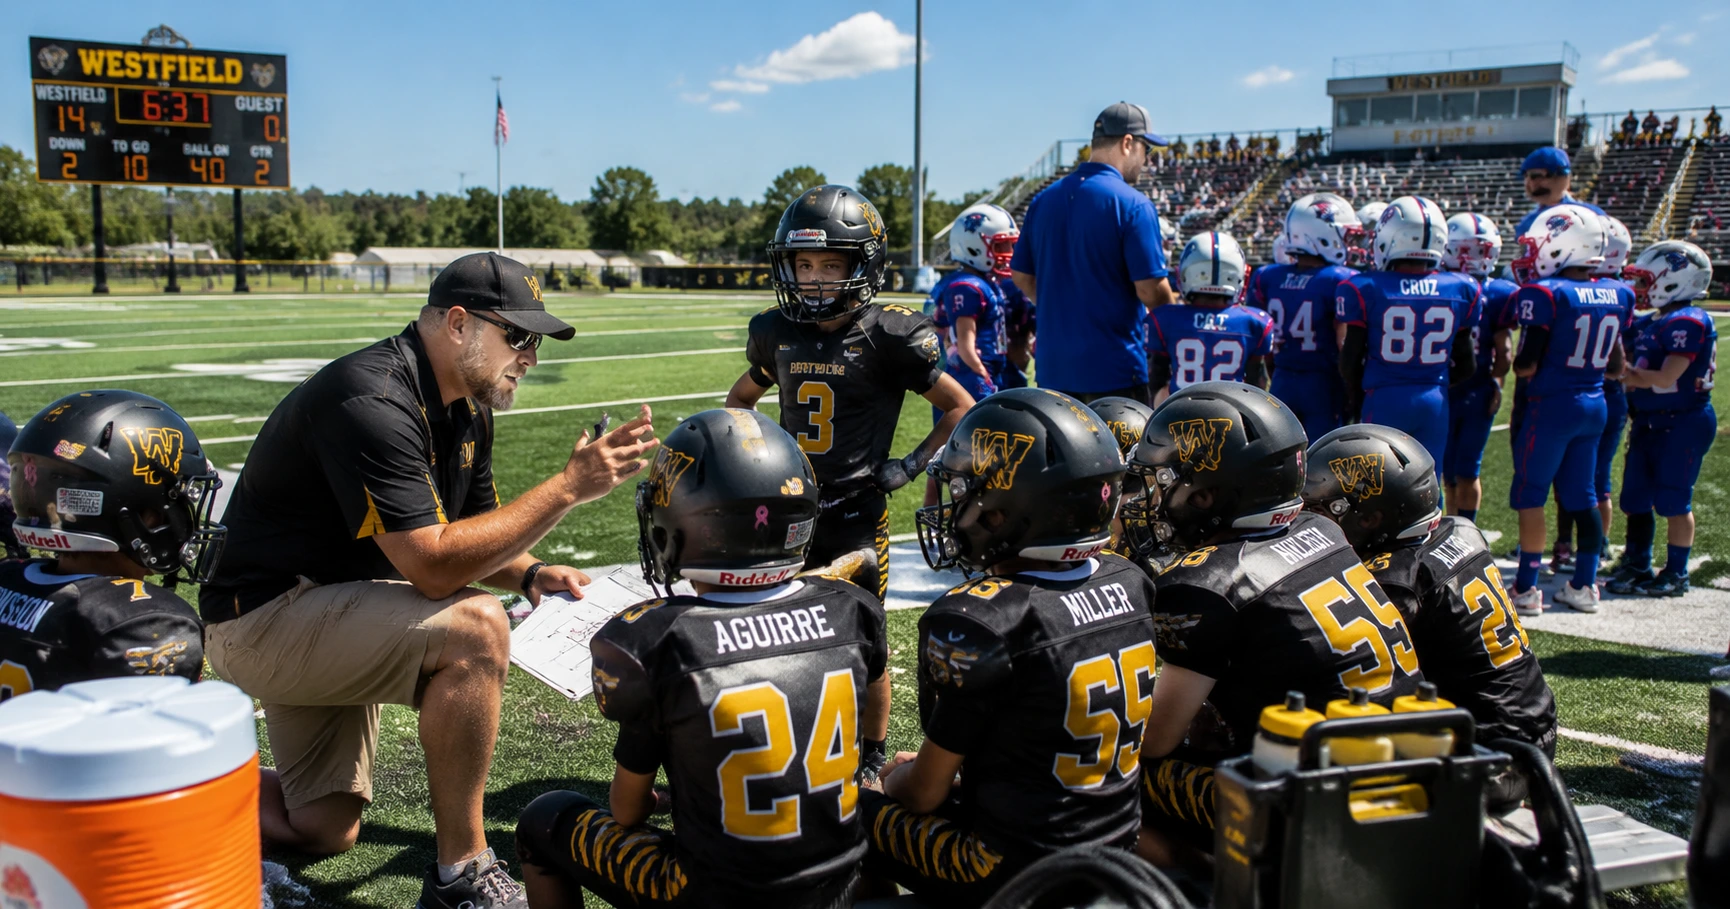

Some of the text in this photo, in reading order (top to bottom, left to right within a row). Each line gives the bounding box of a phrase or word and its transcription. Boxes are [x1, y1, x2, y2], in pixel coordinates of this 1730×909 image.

[77, 48, 243, 84] WESTFIELD
[35, 84, 107, 103] WESTFIELD
[143, 90, 209, 123] 6:37
[235, 95, 283, 112] GUEST
[58, 105, 85, 132] 14
[49, 137, 86, 151] DOWN
[112, 139, 150, 154] TO GO
[183, 143, 230, 156] BALL ON
[62, 152, 78, 179] 2
[124, 155, 148, 181] 10
[190, 157, 225, 183] 40
[254, 160, 270, 185] 2
[1400, 278, 1440, 297] CRUZ
[1574, 287, 1619, 305] WILSON
[1381, 305, 1455, 366] 82
[1567, 314, 1620, 369] 10
[1176, 338, 1243, 390] 82
[797, 381, 835, 455] 3
[1060, 582, 1135, 627] MILLER
[713, 604, 835, 655] AGUIRRE
[1298, 562, 1419, 695] 55
[1052, 640, 1157, 790] 55
[709, 668, 860, 842] 24
